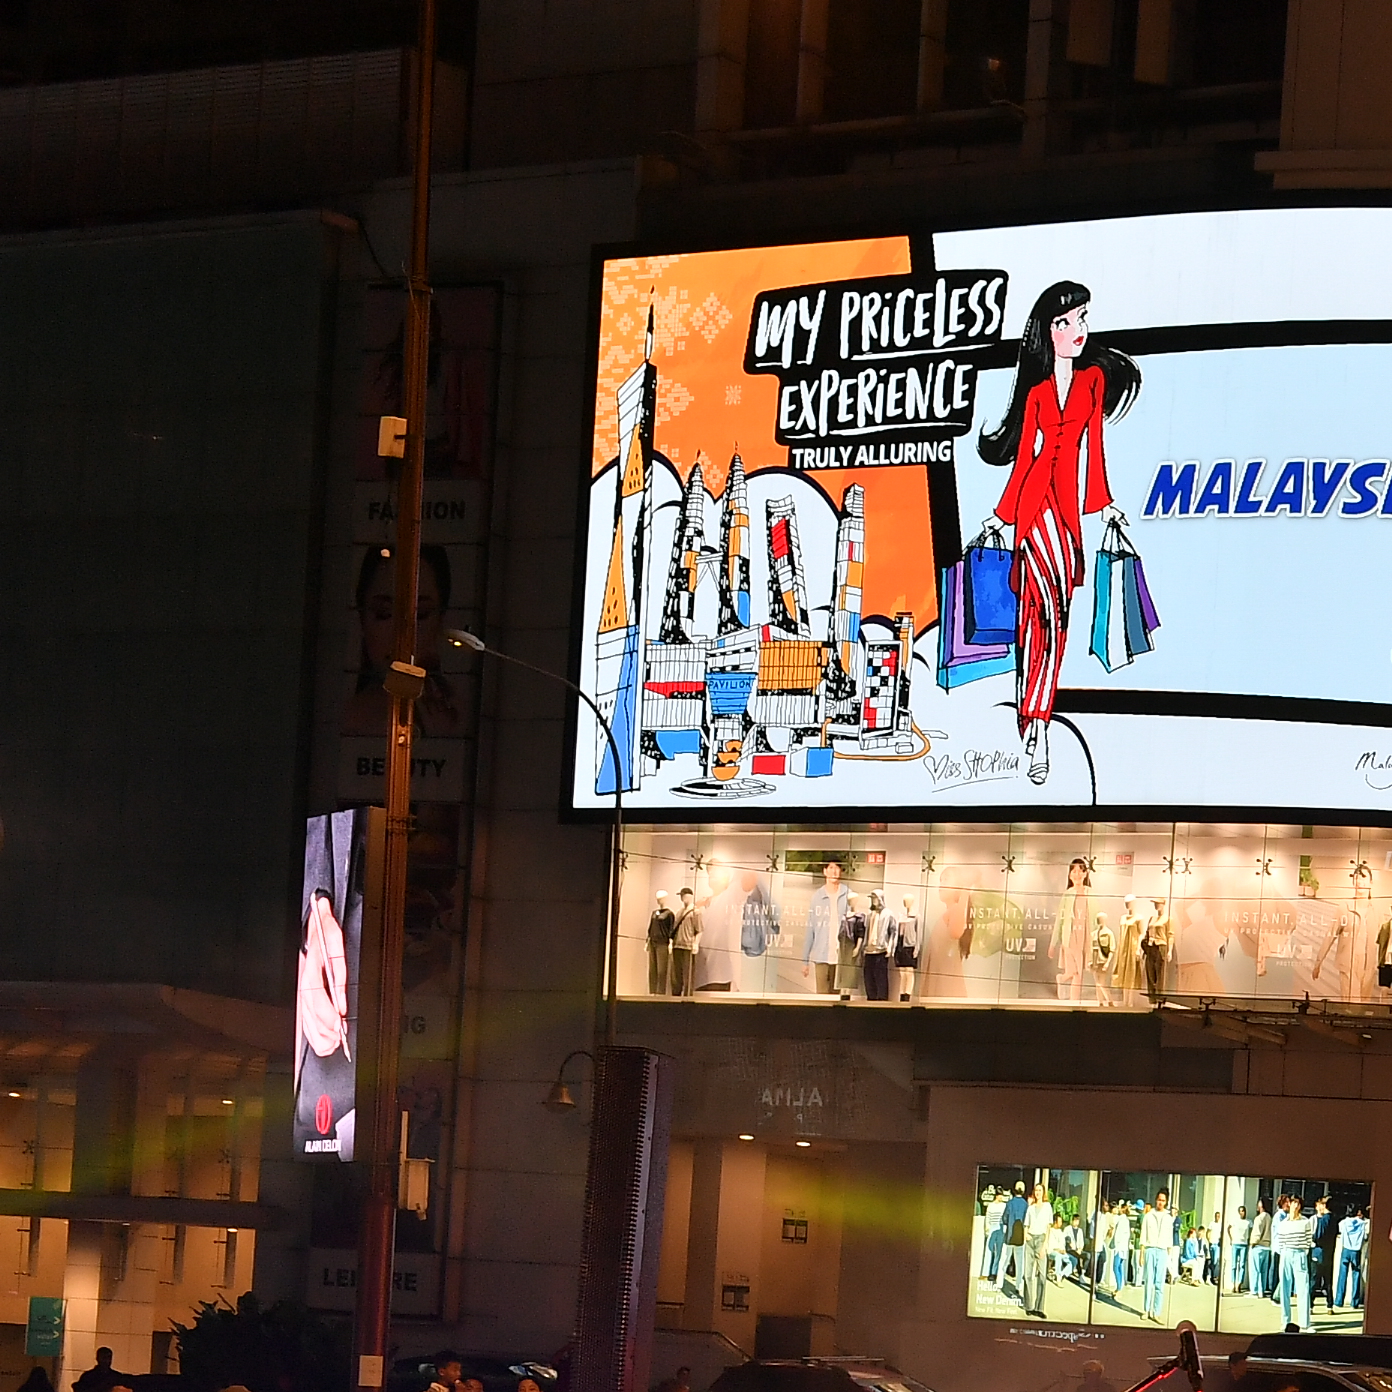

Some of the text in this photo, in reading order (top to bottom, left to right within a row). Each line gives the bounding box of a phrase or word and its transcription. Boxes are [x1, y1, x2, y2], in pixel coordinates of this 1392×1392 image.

[753, 289, 824, 366] MY
[792, 443, 954, 470] TRULY ALLURING
[368, 500, 466, 521] FAION
